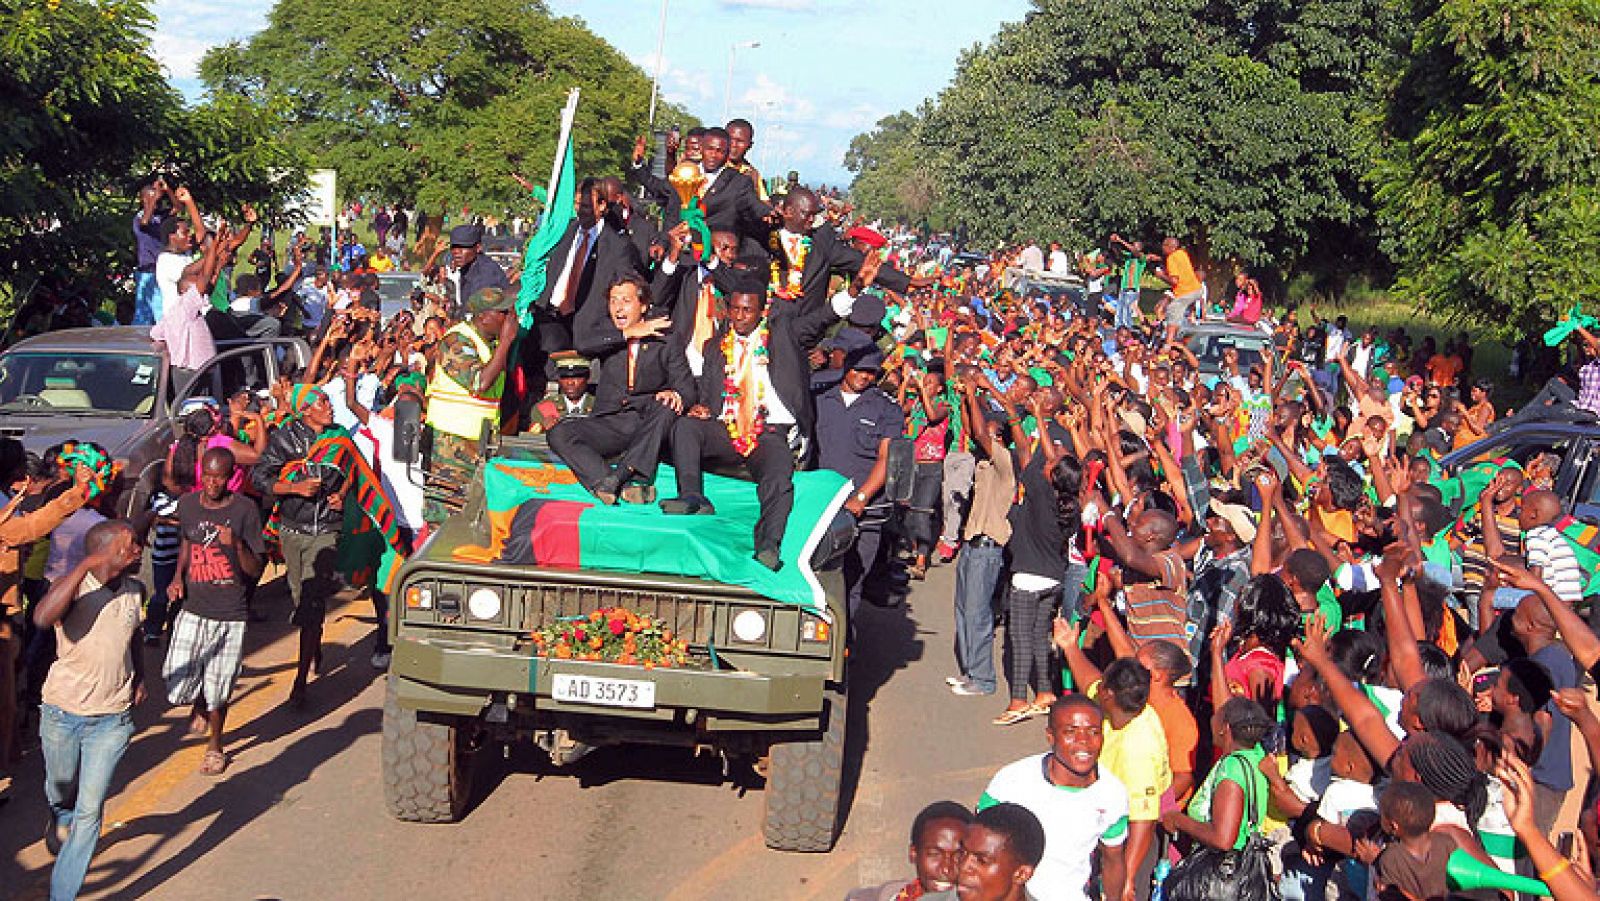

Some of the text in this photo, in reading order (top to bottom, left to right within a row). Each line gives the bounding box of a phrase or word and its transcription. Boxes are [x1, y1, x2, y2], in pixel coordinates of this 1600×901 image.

[191, 543, 229, 563] BE
[189, 562, 234, 582] MINE
[568, 679, 638, 702] AD 3573
